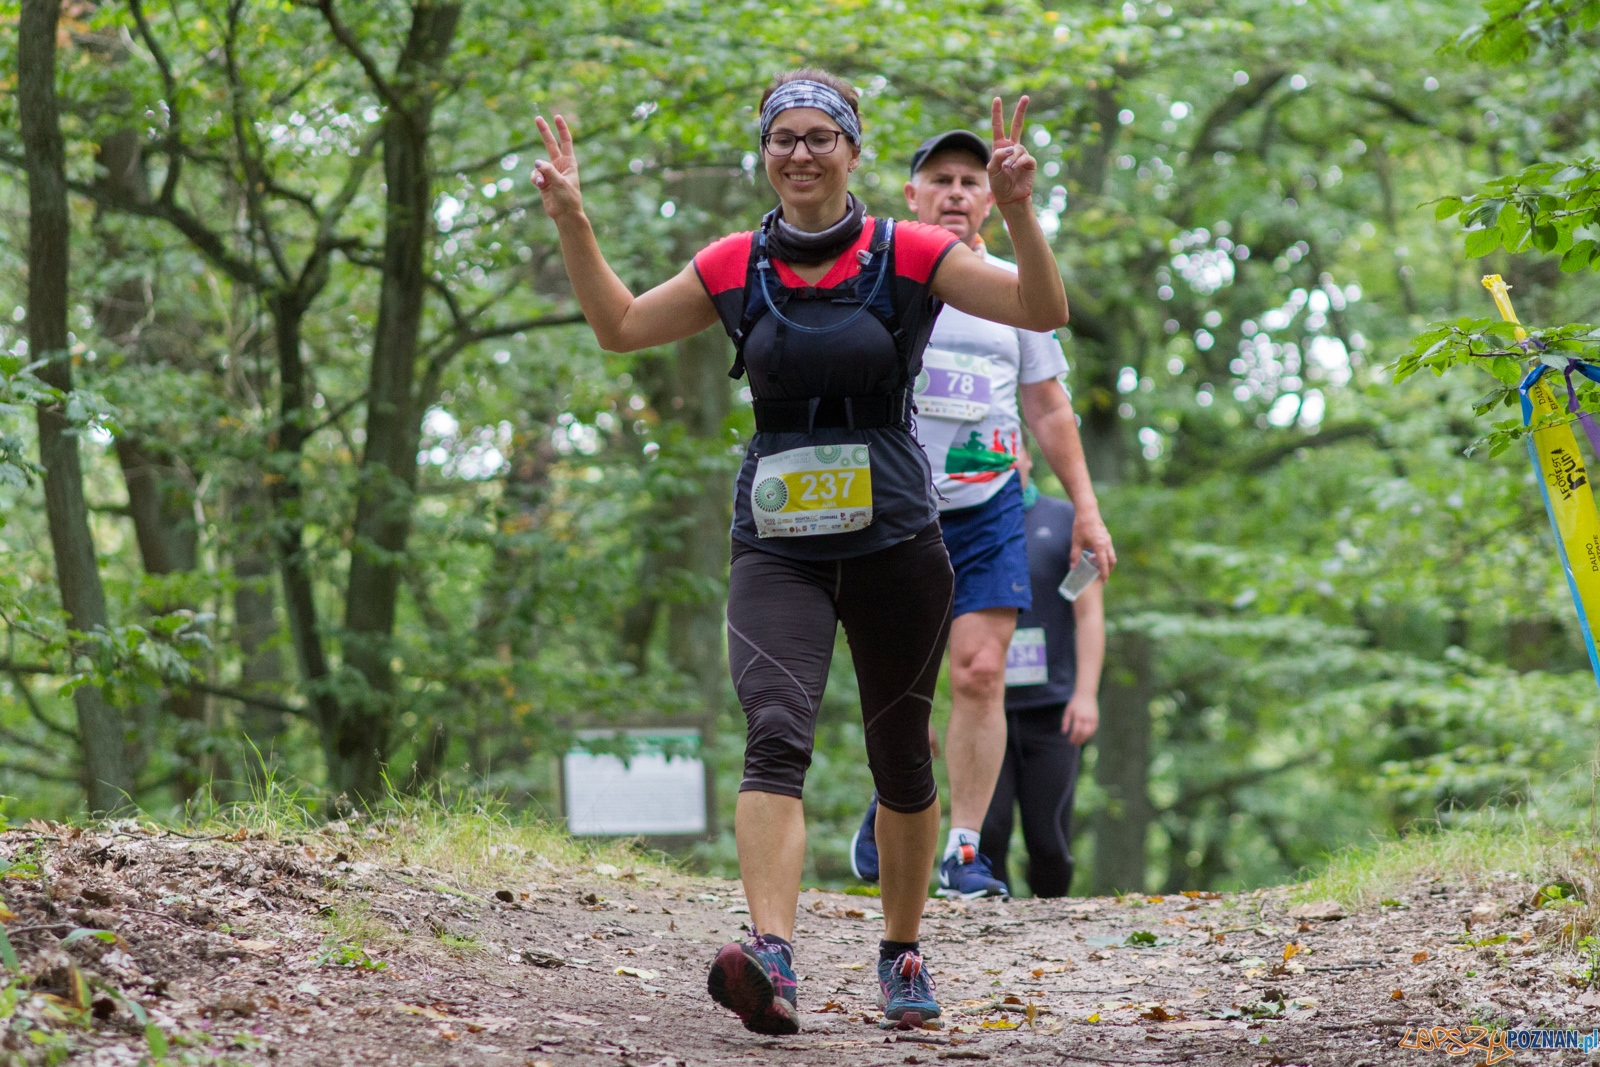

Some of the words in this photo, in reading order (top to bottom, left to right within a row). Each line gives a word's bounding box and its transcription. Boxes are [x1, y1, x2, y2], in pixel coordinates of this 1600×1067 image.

[947, 371, 974, 395] 78
[800, 471, 855, 501] 237
[1551, 457, 1569, 495] FOREST
[1586, 543, 1599, 572] DALPO
